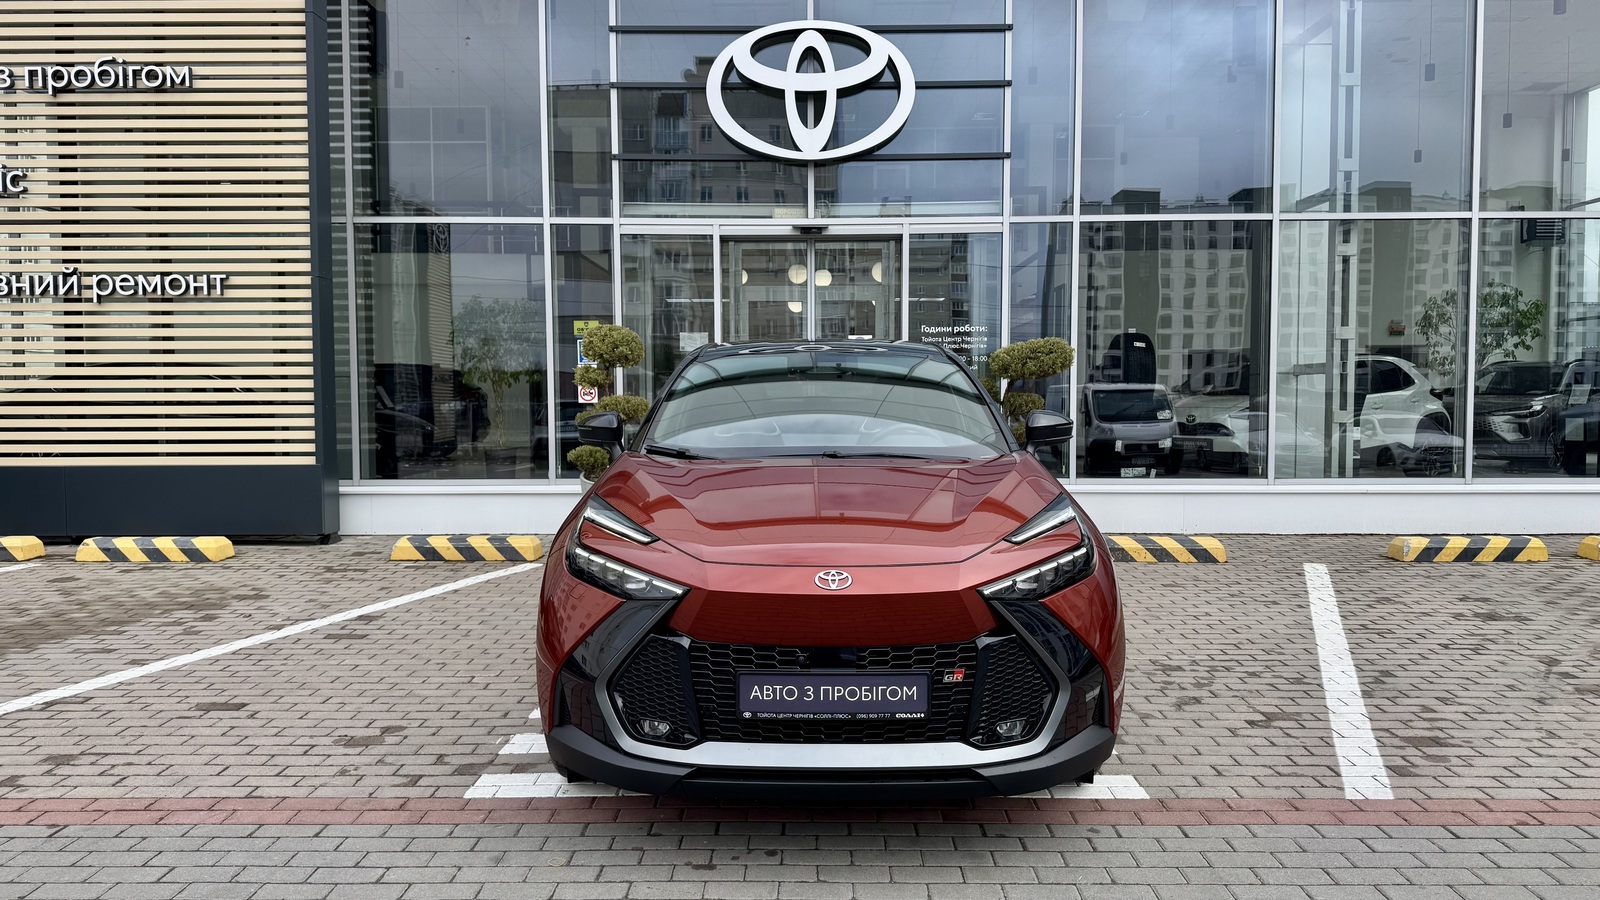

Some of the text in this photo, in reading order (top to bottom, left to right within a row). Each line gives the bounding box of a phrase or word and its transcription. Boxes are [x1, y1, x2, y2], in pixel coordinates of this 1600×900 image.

[0, 56, 191, 95] з пробігом
[93, 273, 227, 303] ремонт
[921, 324, 988, 334] Години роботи:
[944, 672, 963, 682] GR
[750, 685, 917, 701] АВТО З ПРОБІГОМ
